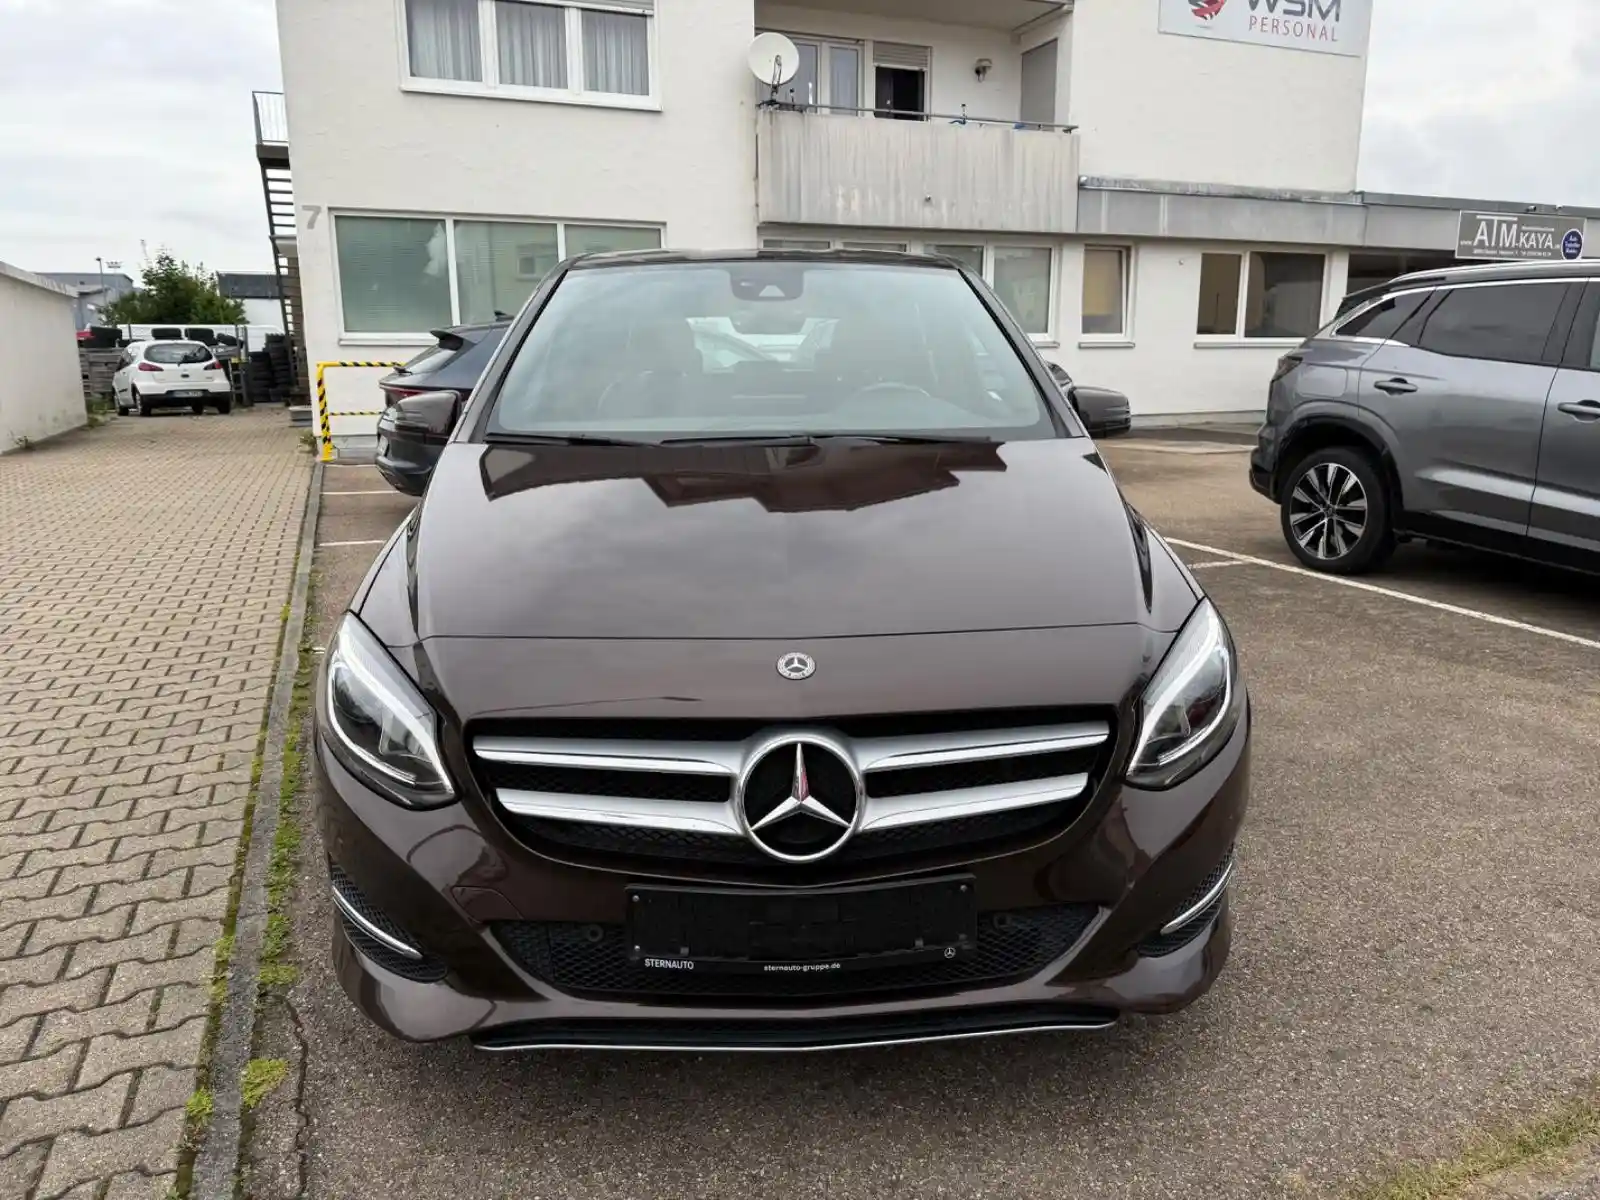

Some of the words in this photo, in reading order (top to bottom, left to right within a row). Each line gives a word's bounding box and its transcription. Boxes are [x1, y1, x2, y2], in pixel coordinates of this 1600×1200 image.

[1249, 15, 1338, 42] PERSONAL
[302, 205, 321, 230] 7
[644, 958, 694, 970] STERNAUTO
[764, 962, 841, 972] sternauto-gruppe.de
